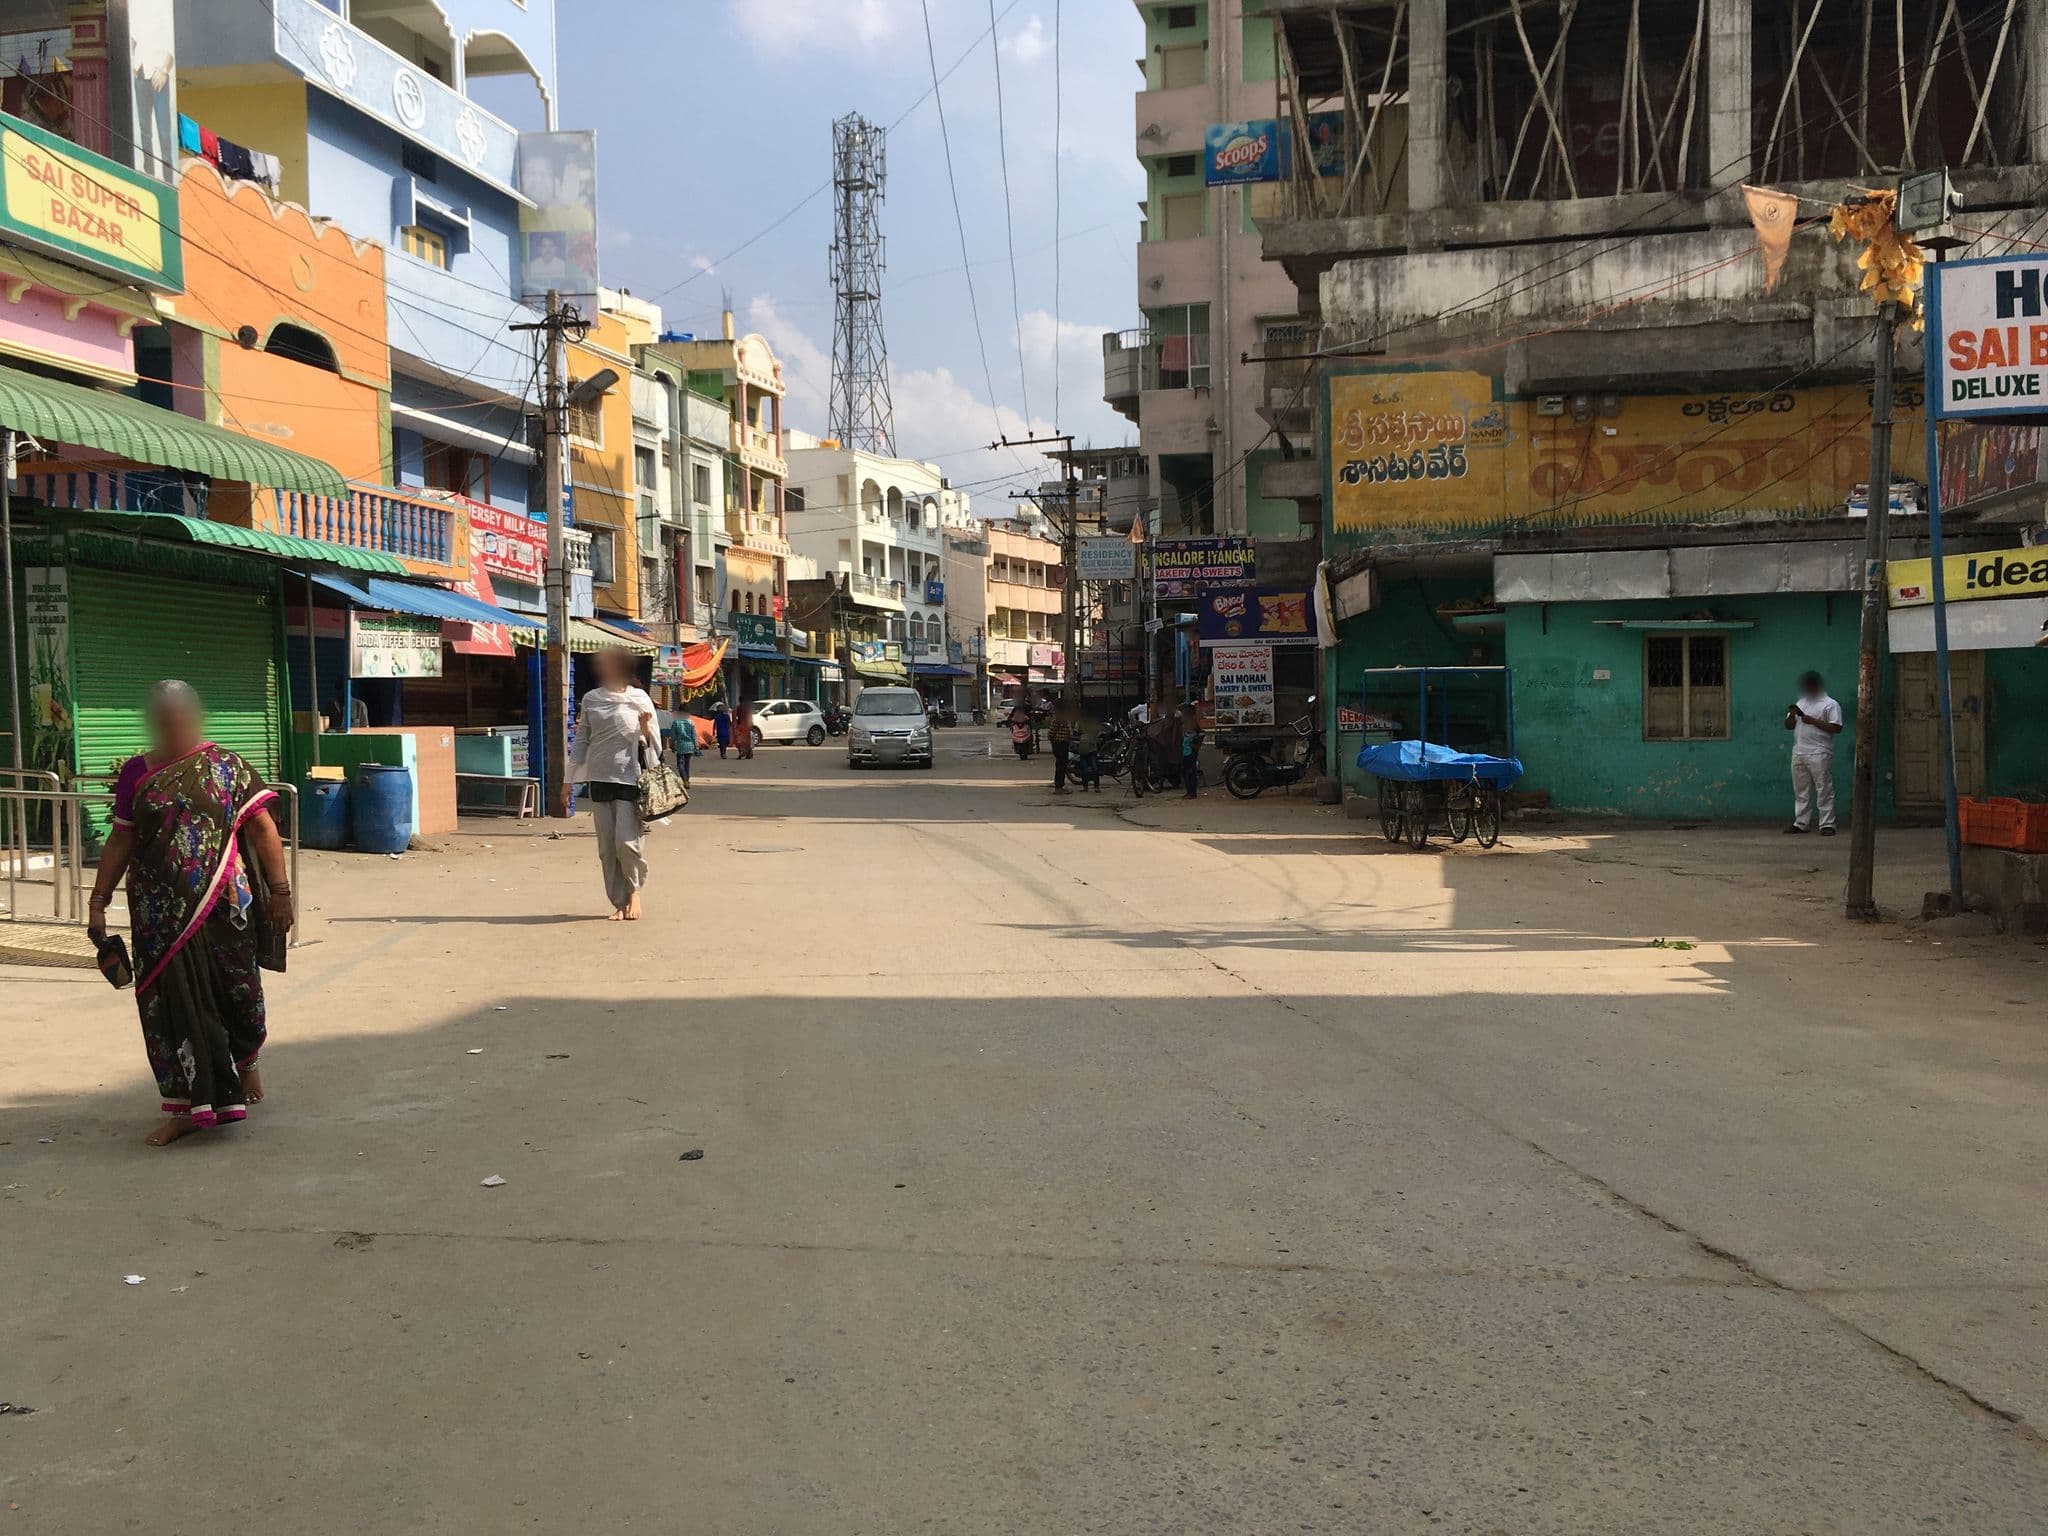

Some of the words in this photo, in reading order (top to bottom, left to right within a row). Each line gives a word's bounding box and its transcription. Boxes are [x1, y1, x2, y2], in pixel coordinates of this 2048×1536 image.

[1215, 135, 1267, 170] Scoops
[25, 154, 64, 191] SAI
[71, 172, 142, 222] SUPER
[50, 198, 125, 248] BAZAR
[1996, 268, 2048, 319] H
[1948, 327, 2019, 371] SAI
[1952, 374, 2041, 401] DELUXE
[504, 514, 526, 534] MILK
[527, 523, 548, 542] DAIR
[1081, 549, 1132, 559] RESIDENCY
[1141, 550, 1205, 567] BNGALORE
[1208, 549, 1255, 565] IYANGAR
[1193, 567, 1201, 578] &
[1202, 566, 1243, 578] SWEETS
[357, 633, 380, 648] DADA
[381, 634, 409, 649] TIFFEN
[410, 635, 441, 649] CENTER
[1215, 685, 1240, 693] BAKERY
[1241, 684, 1247, 692] &
[1248, 684, 1272, 692] SWEETS
[1220, 674, 1234, 683] SAI
[1236, 674, 1267, 683] MOHAN
